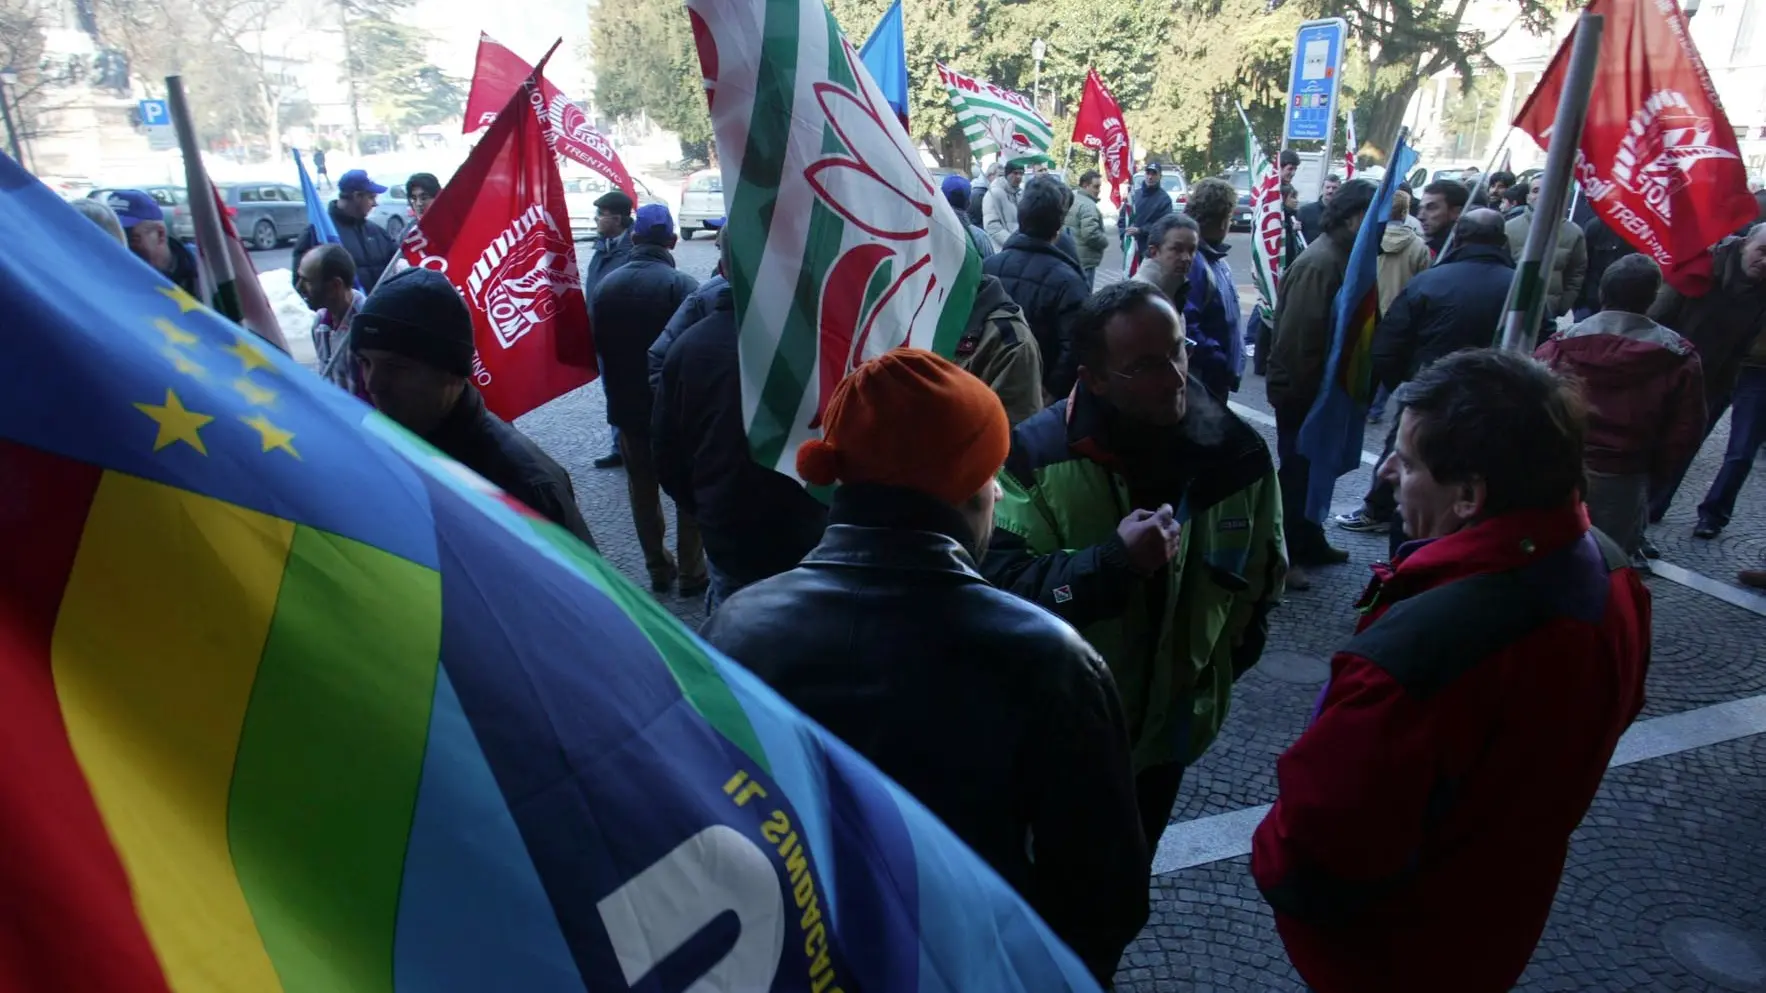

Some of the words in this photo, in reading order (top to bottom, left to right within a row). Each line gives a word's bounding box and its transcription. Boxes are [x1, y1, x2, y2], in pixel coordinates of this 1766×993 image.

[144, 102, 162, 123] P
[564, 143, 623, 184] TRENTINO
[490, 288, 527, 338] FIOM
